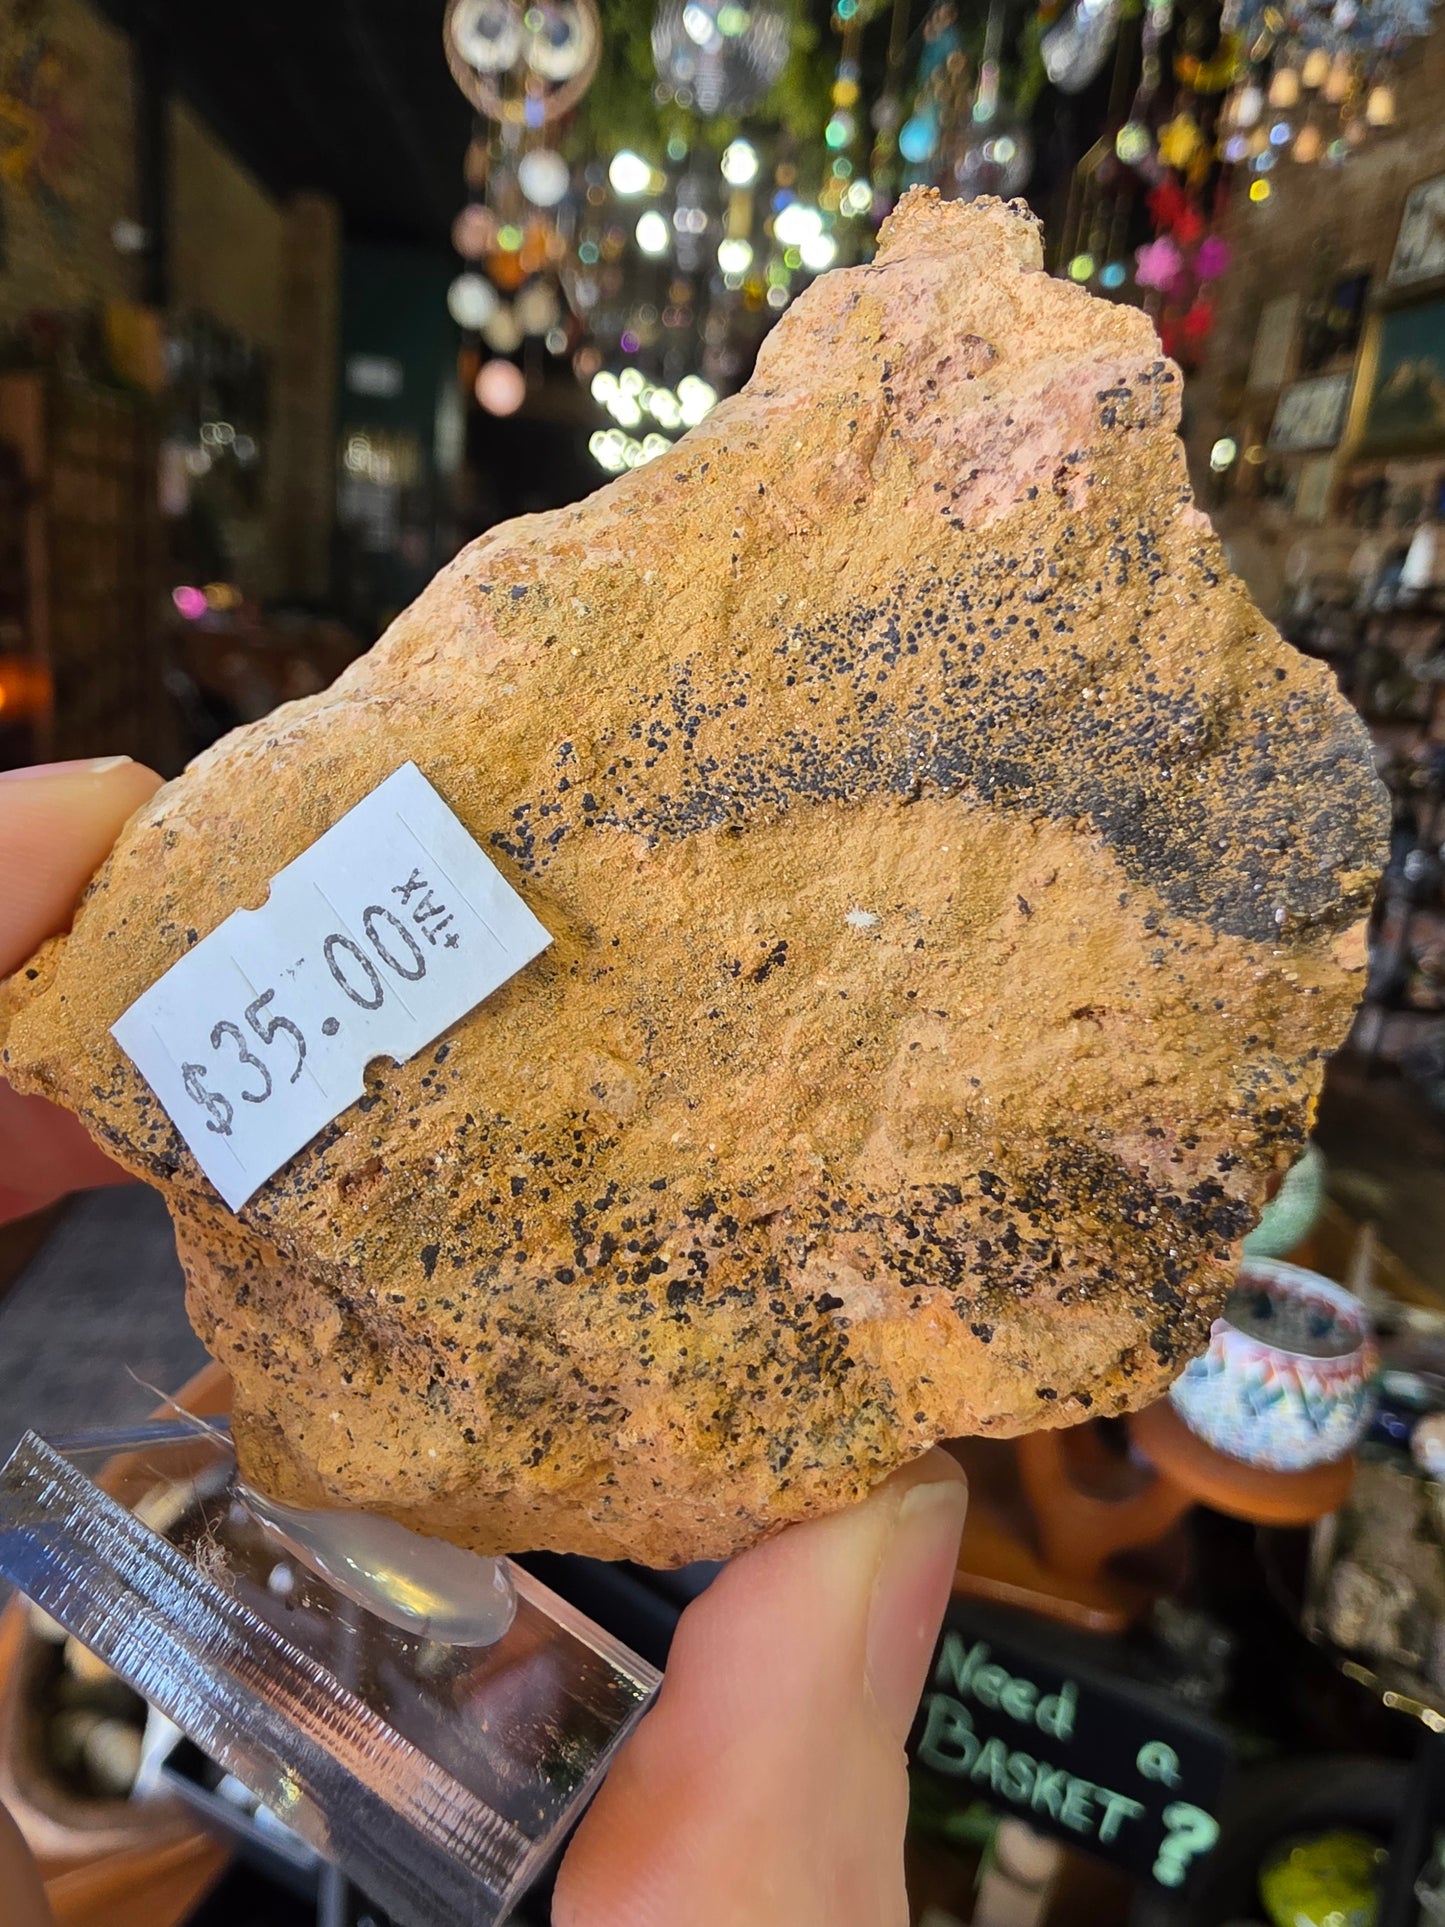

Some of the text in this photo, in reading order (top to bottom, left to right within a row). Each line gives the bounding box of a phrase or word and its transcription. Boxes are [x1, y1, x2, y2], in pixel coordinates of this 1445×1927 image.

[182, 905, 427, 1135] $35.00
[936, 1633, 1182, 1790] Need a
